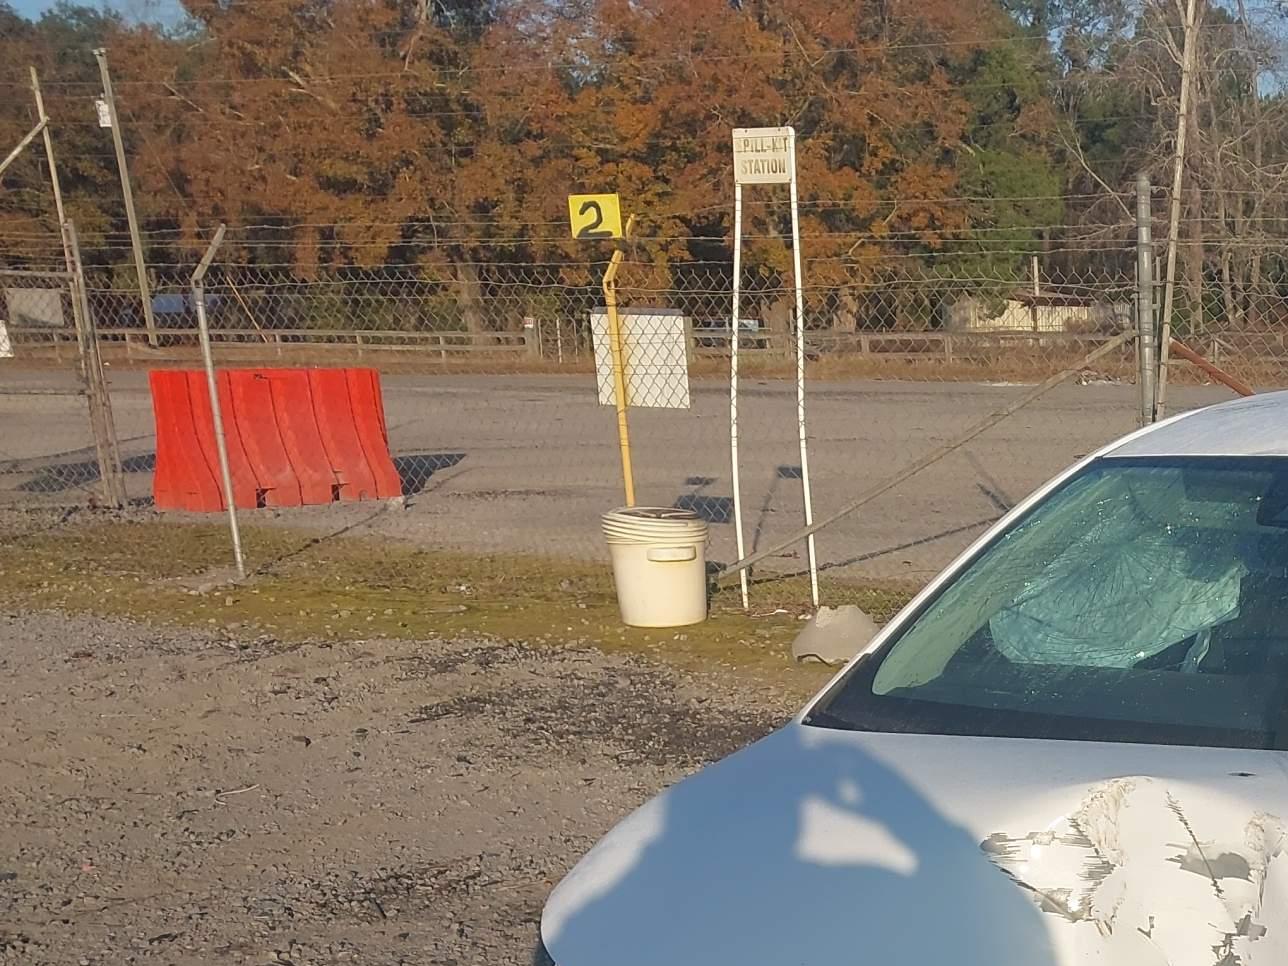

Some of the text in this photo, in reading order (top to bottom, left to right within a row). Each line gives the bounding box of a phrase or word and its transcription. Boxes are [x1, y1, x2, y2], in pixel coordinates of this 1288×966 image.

[735, 137, 788, 153] PILL-KT
[741, 159, 786, 175] STATION
[577, 201, 612, 237] 2
